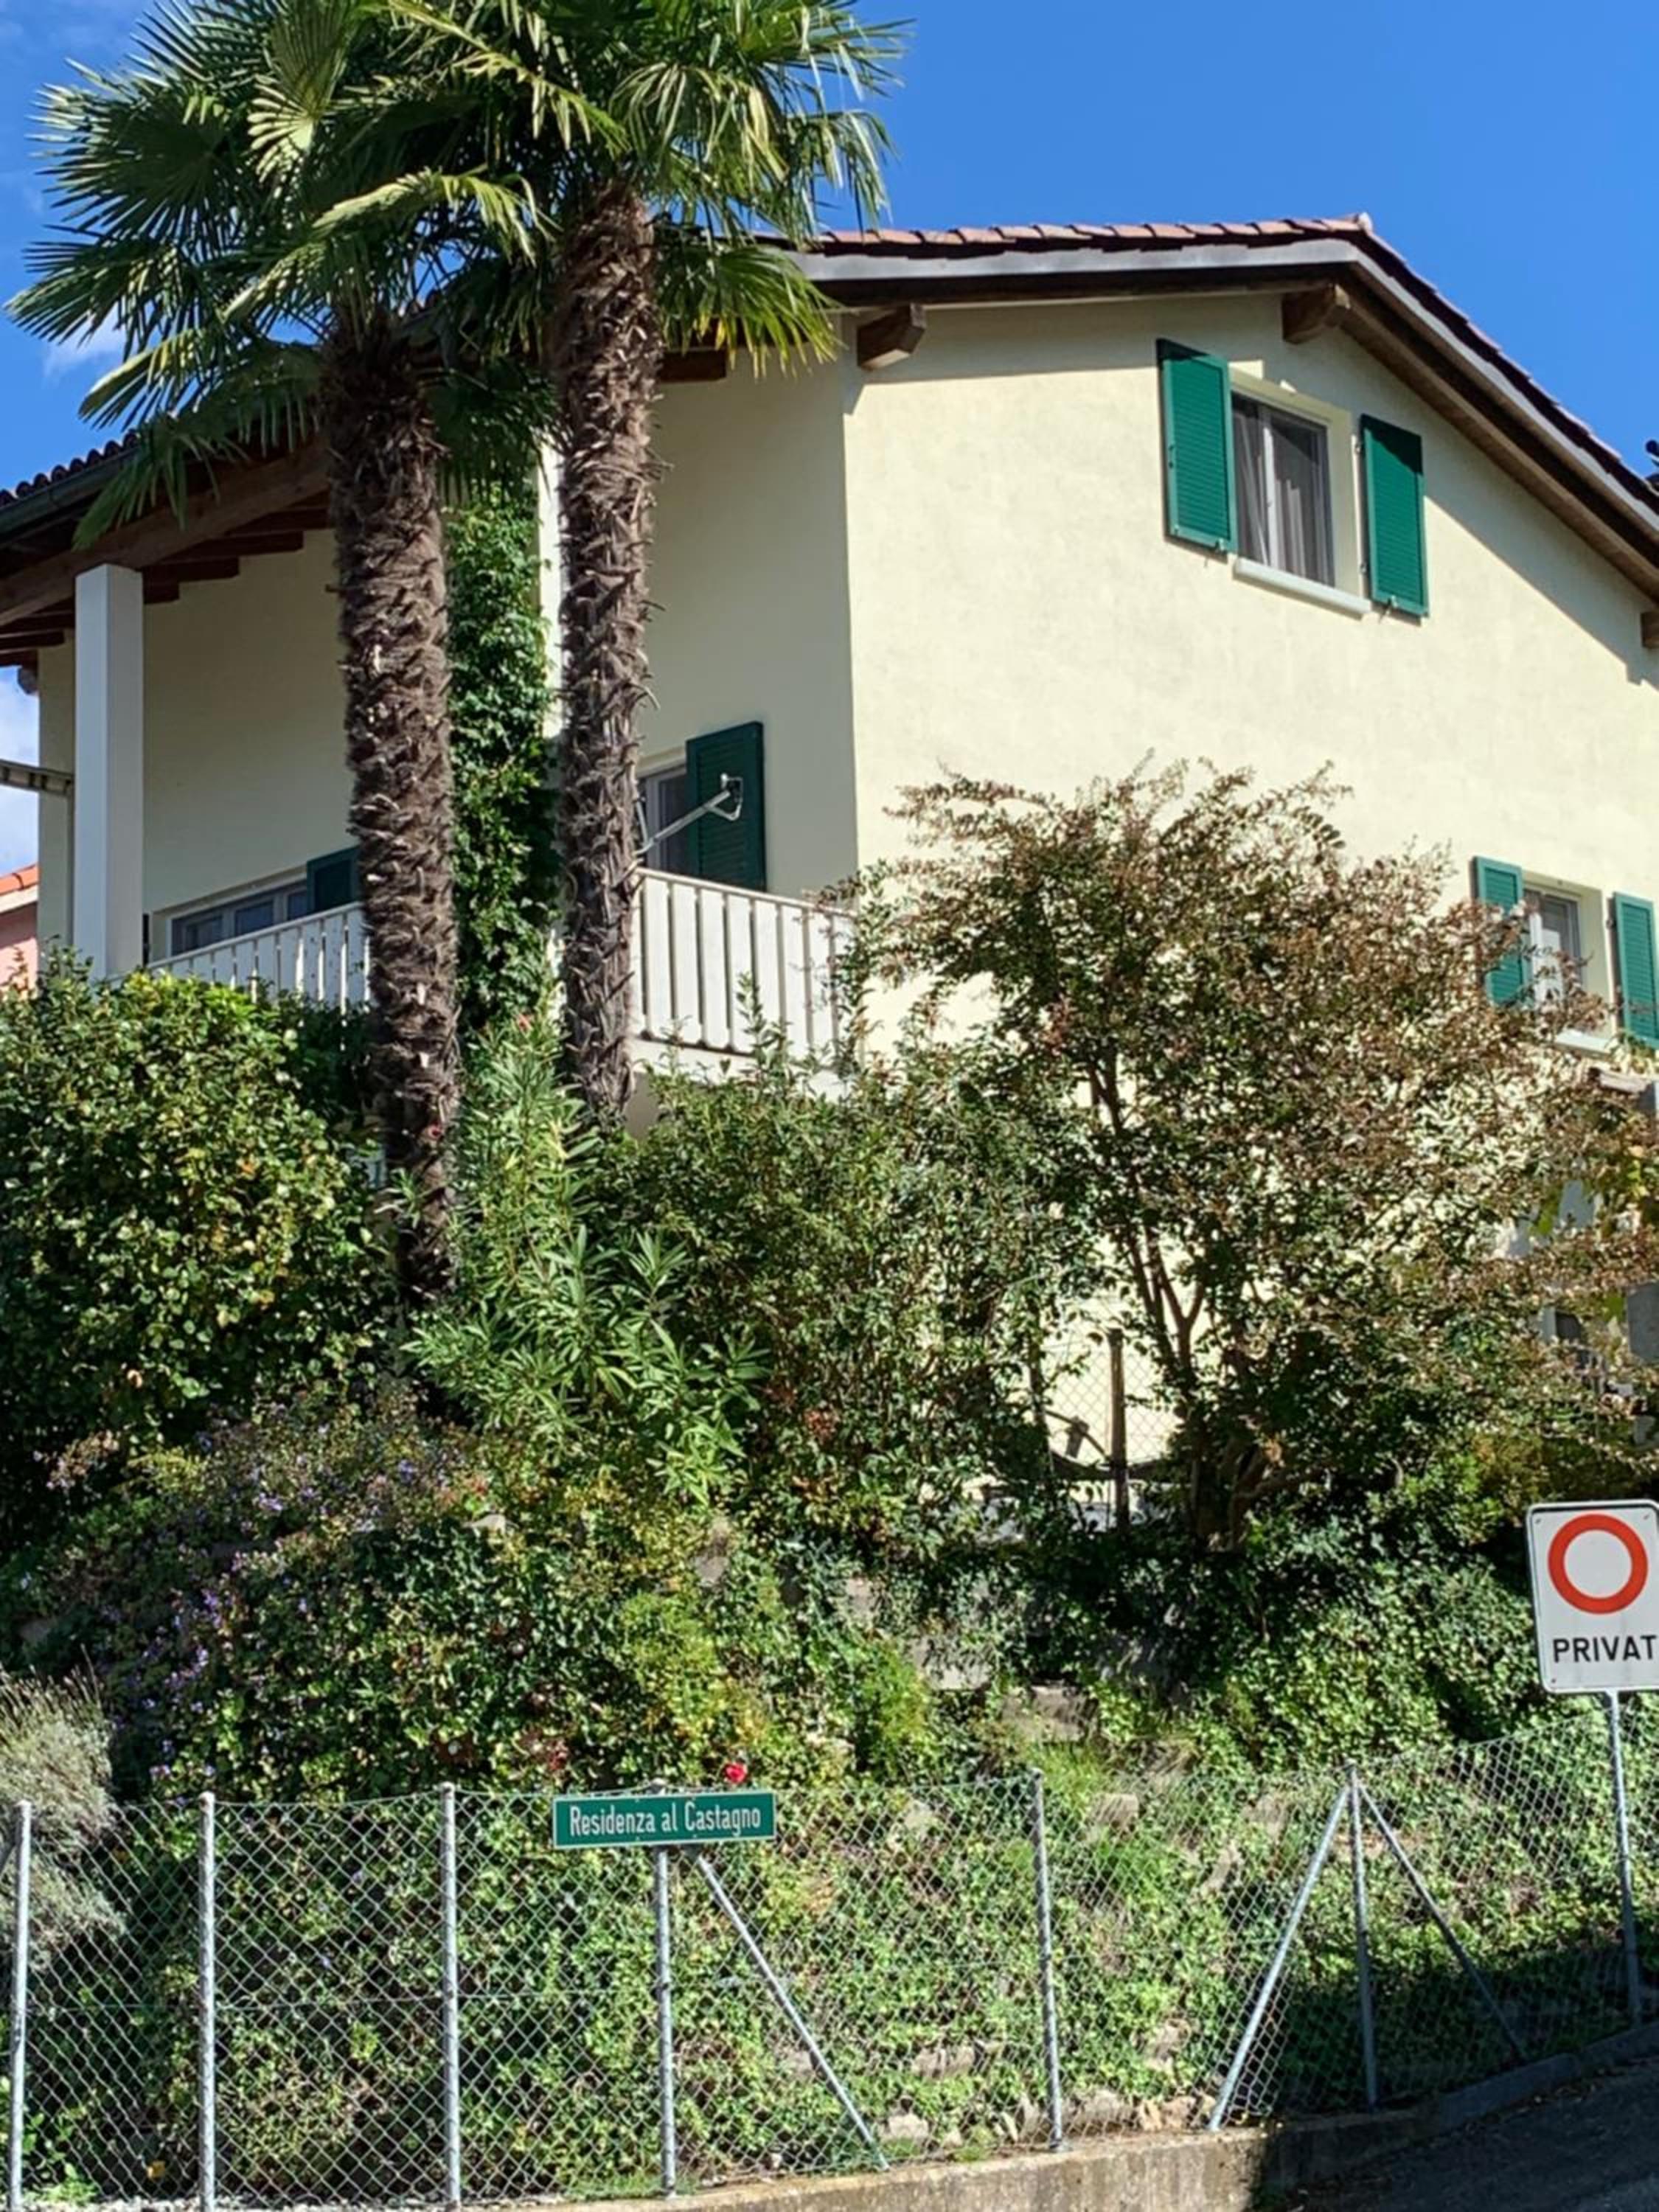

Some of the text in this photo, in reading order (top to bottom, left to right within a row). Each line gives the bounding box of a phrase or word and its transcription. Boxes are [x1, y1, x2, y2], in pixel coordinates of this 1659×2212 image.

[1553, 1635, 1657, 1663] PRIVAT
[569, 1801, 762, 1837] Residenza al Castagno
